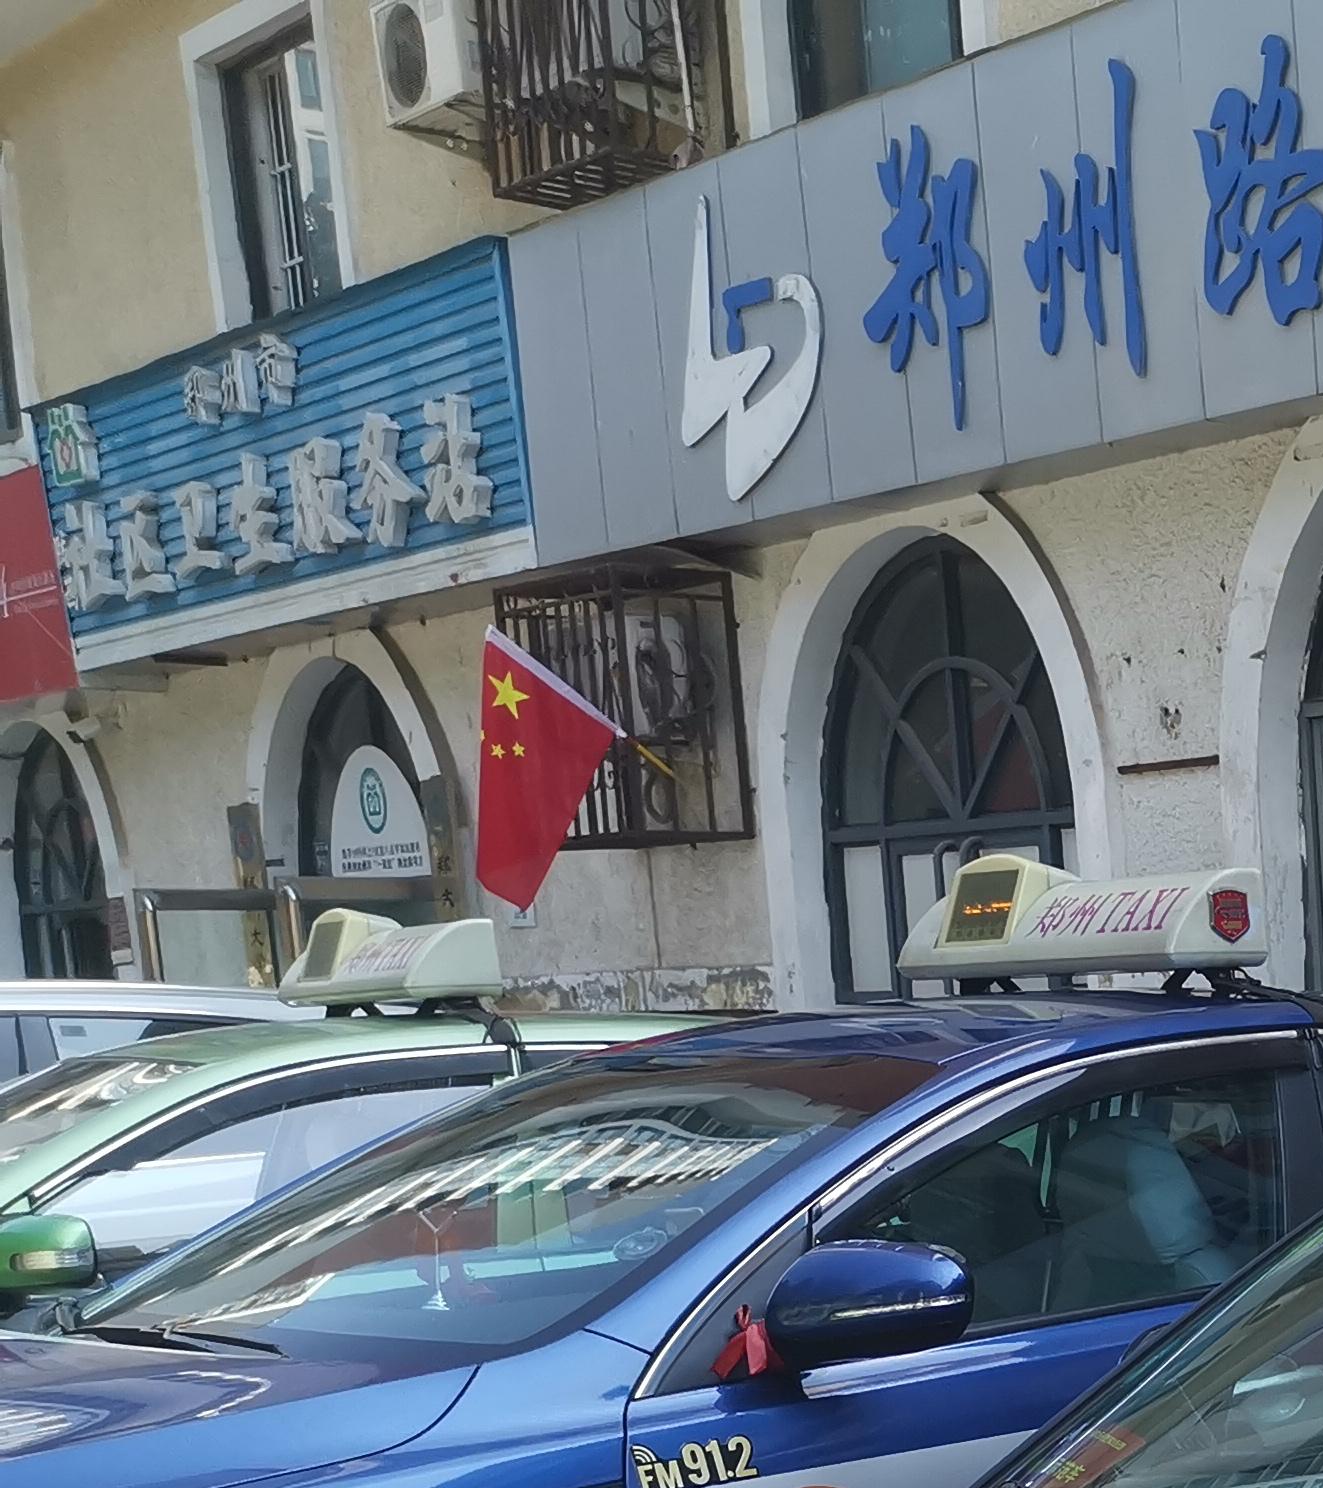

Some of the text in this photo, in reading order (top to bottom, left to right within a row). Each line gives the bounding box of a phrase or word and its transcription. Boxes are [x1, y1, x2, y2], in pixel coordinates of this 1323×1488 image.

[1026, 891, 1106, 938] 郑州
[1096, 886, 1191, 934] TAXI
[680, 1435, 759, 1487] 91.2
